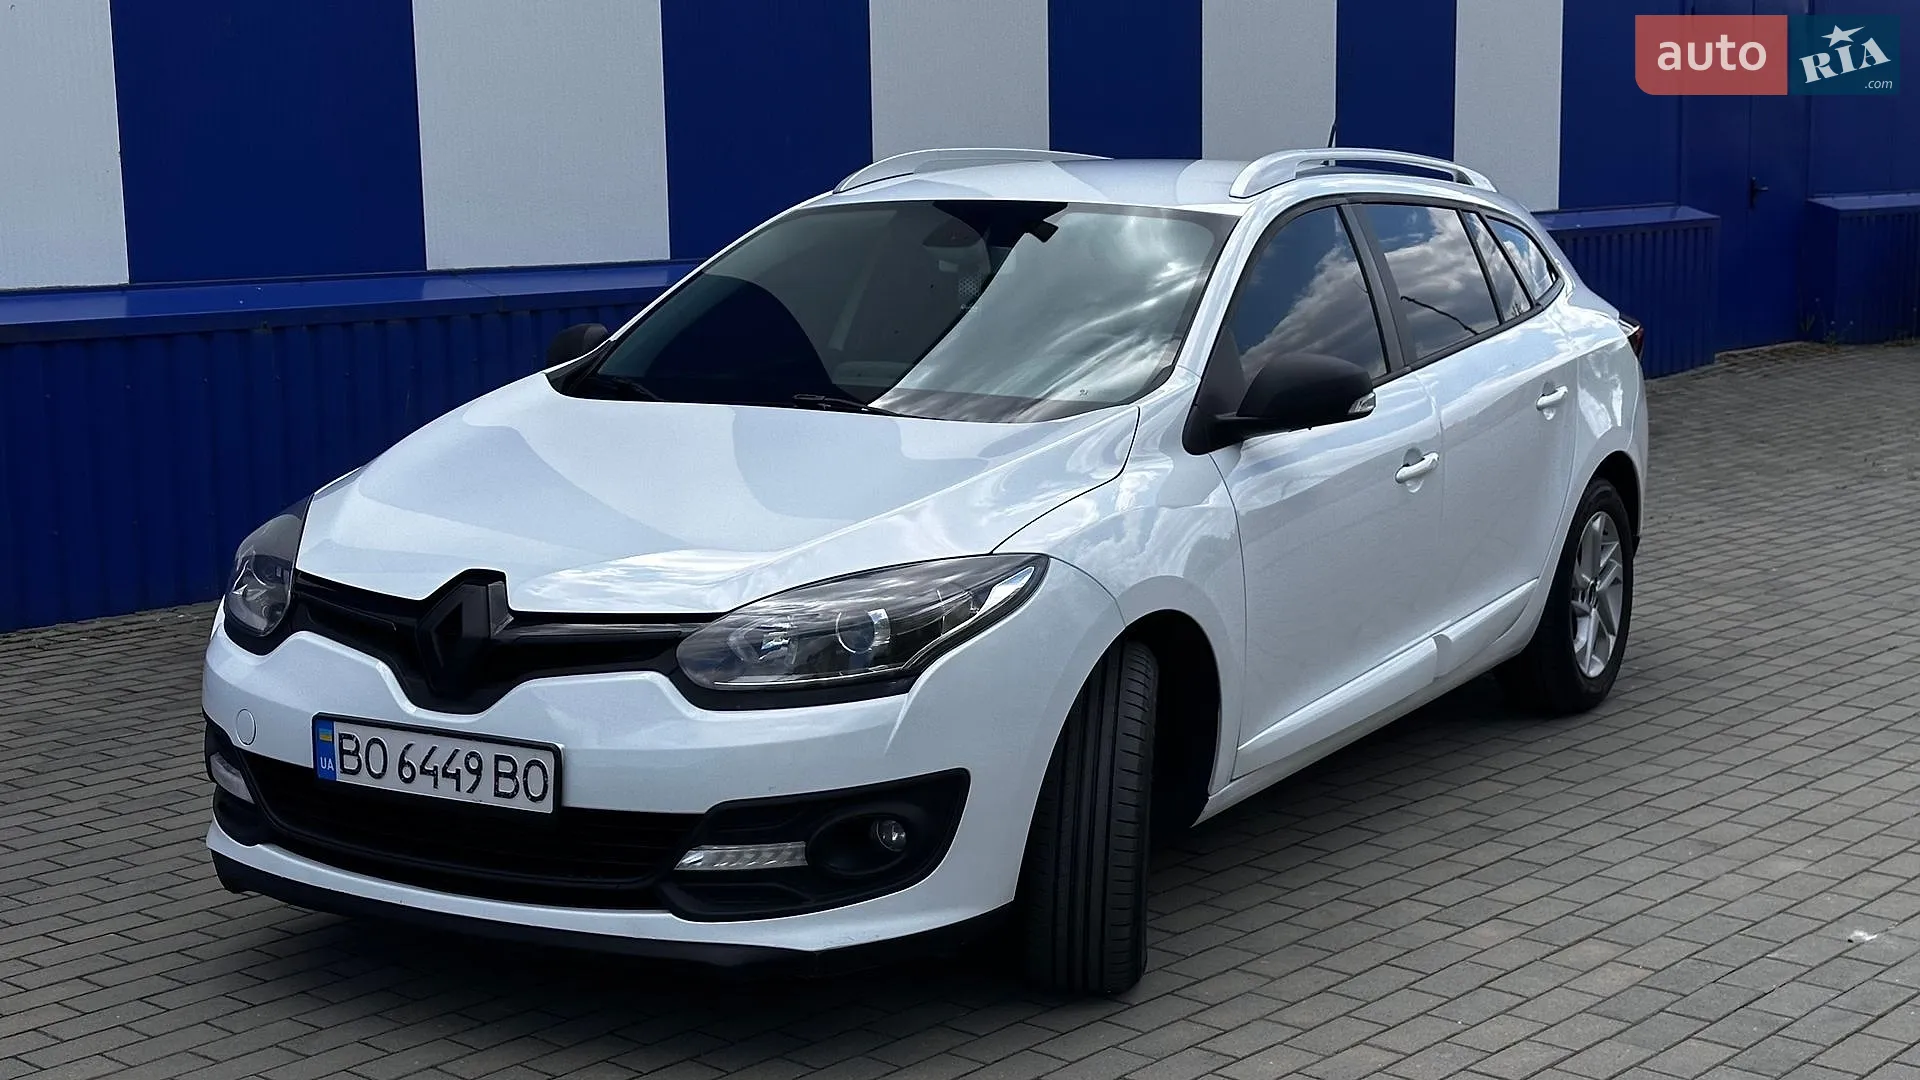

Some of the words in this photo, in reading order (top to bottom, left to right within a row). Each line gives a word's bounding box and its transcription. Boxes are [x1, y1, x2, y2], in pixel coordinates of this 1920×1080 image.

[320, 756, 335, 772] UA
[338, 732, 388, 779] BO
[397, 741, 483, 794] 6449
[493, 753, 549, 803] BO
